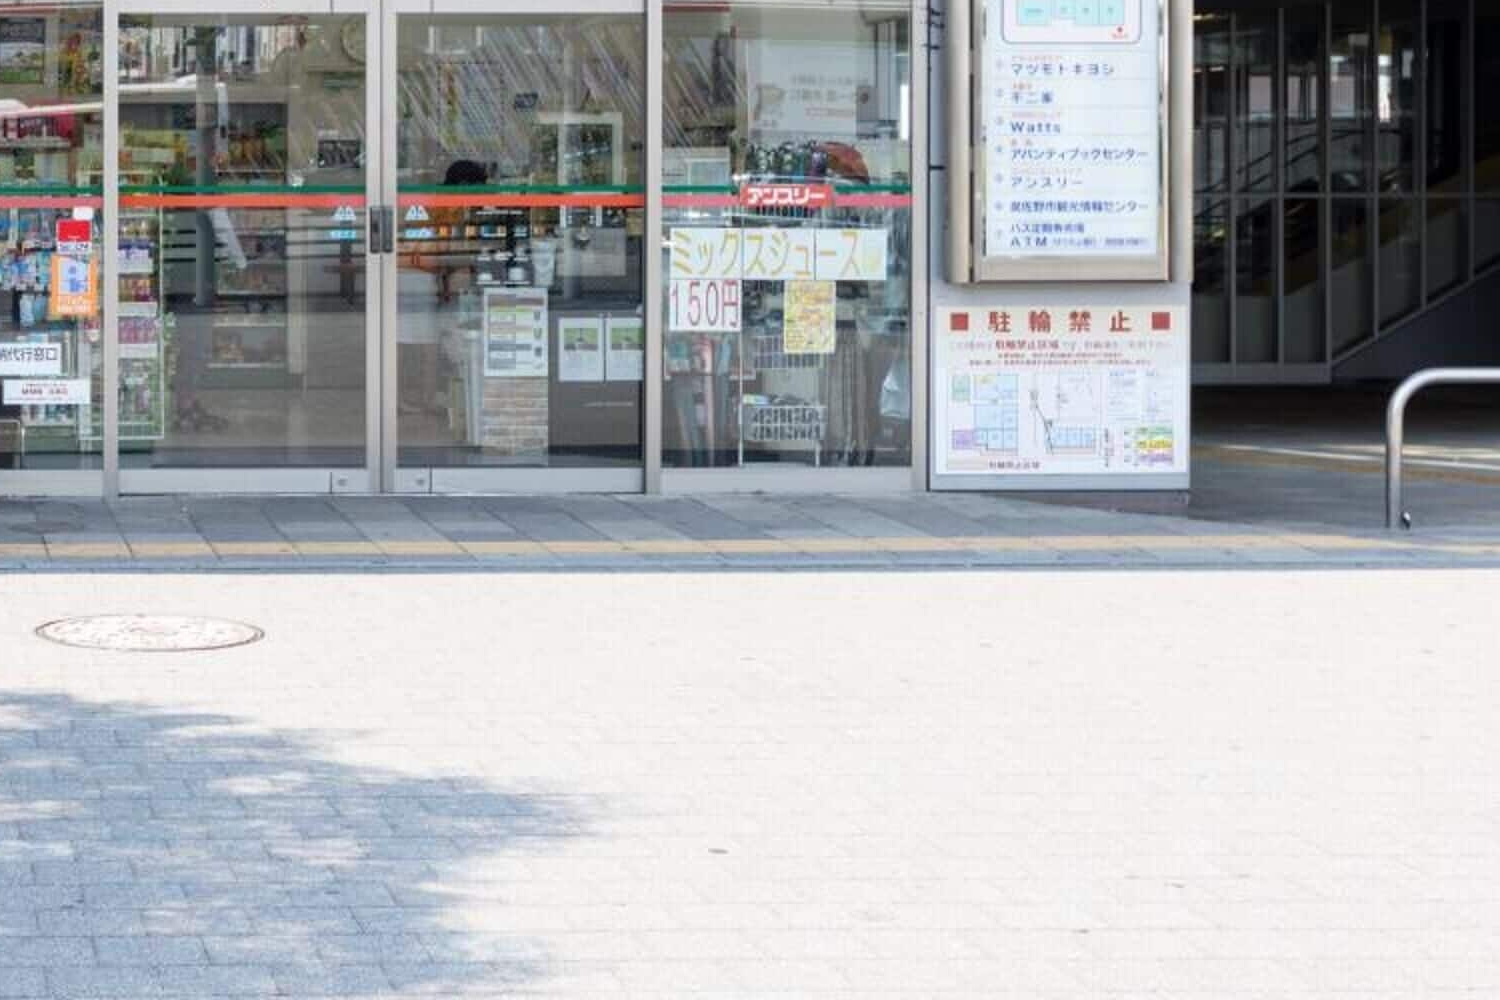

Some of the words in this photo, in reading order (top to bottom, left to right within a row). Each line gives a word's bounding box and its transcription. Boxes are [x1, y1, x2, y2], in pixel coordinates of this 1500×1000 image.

[1010, 121, 1061, 133] Watts
[1011, 176, 1083, 189] アンスリー
[747, 187, 826, 205] アンスリー
[1011, 236, 1047, 248] ATM
[673, 230, 860, 277] ミックスジュース
[671, 280, 739, 328] 150円
[988, 309, 1131, 333] 駐輪禁止
